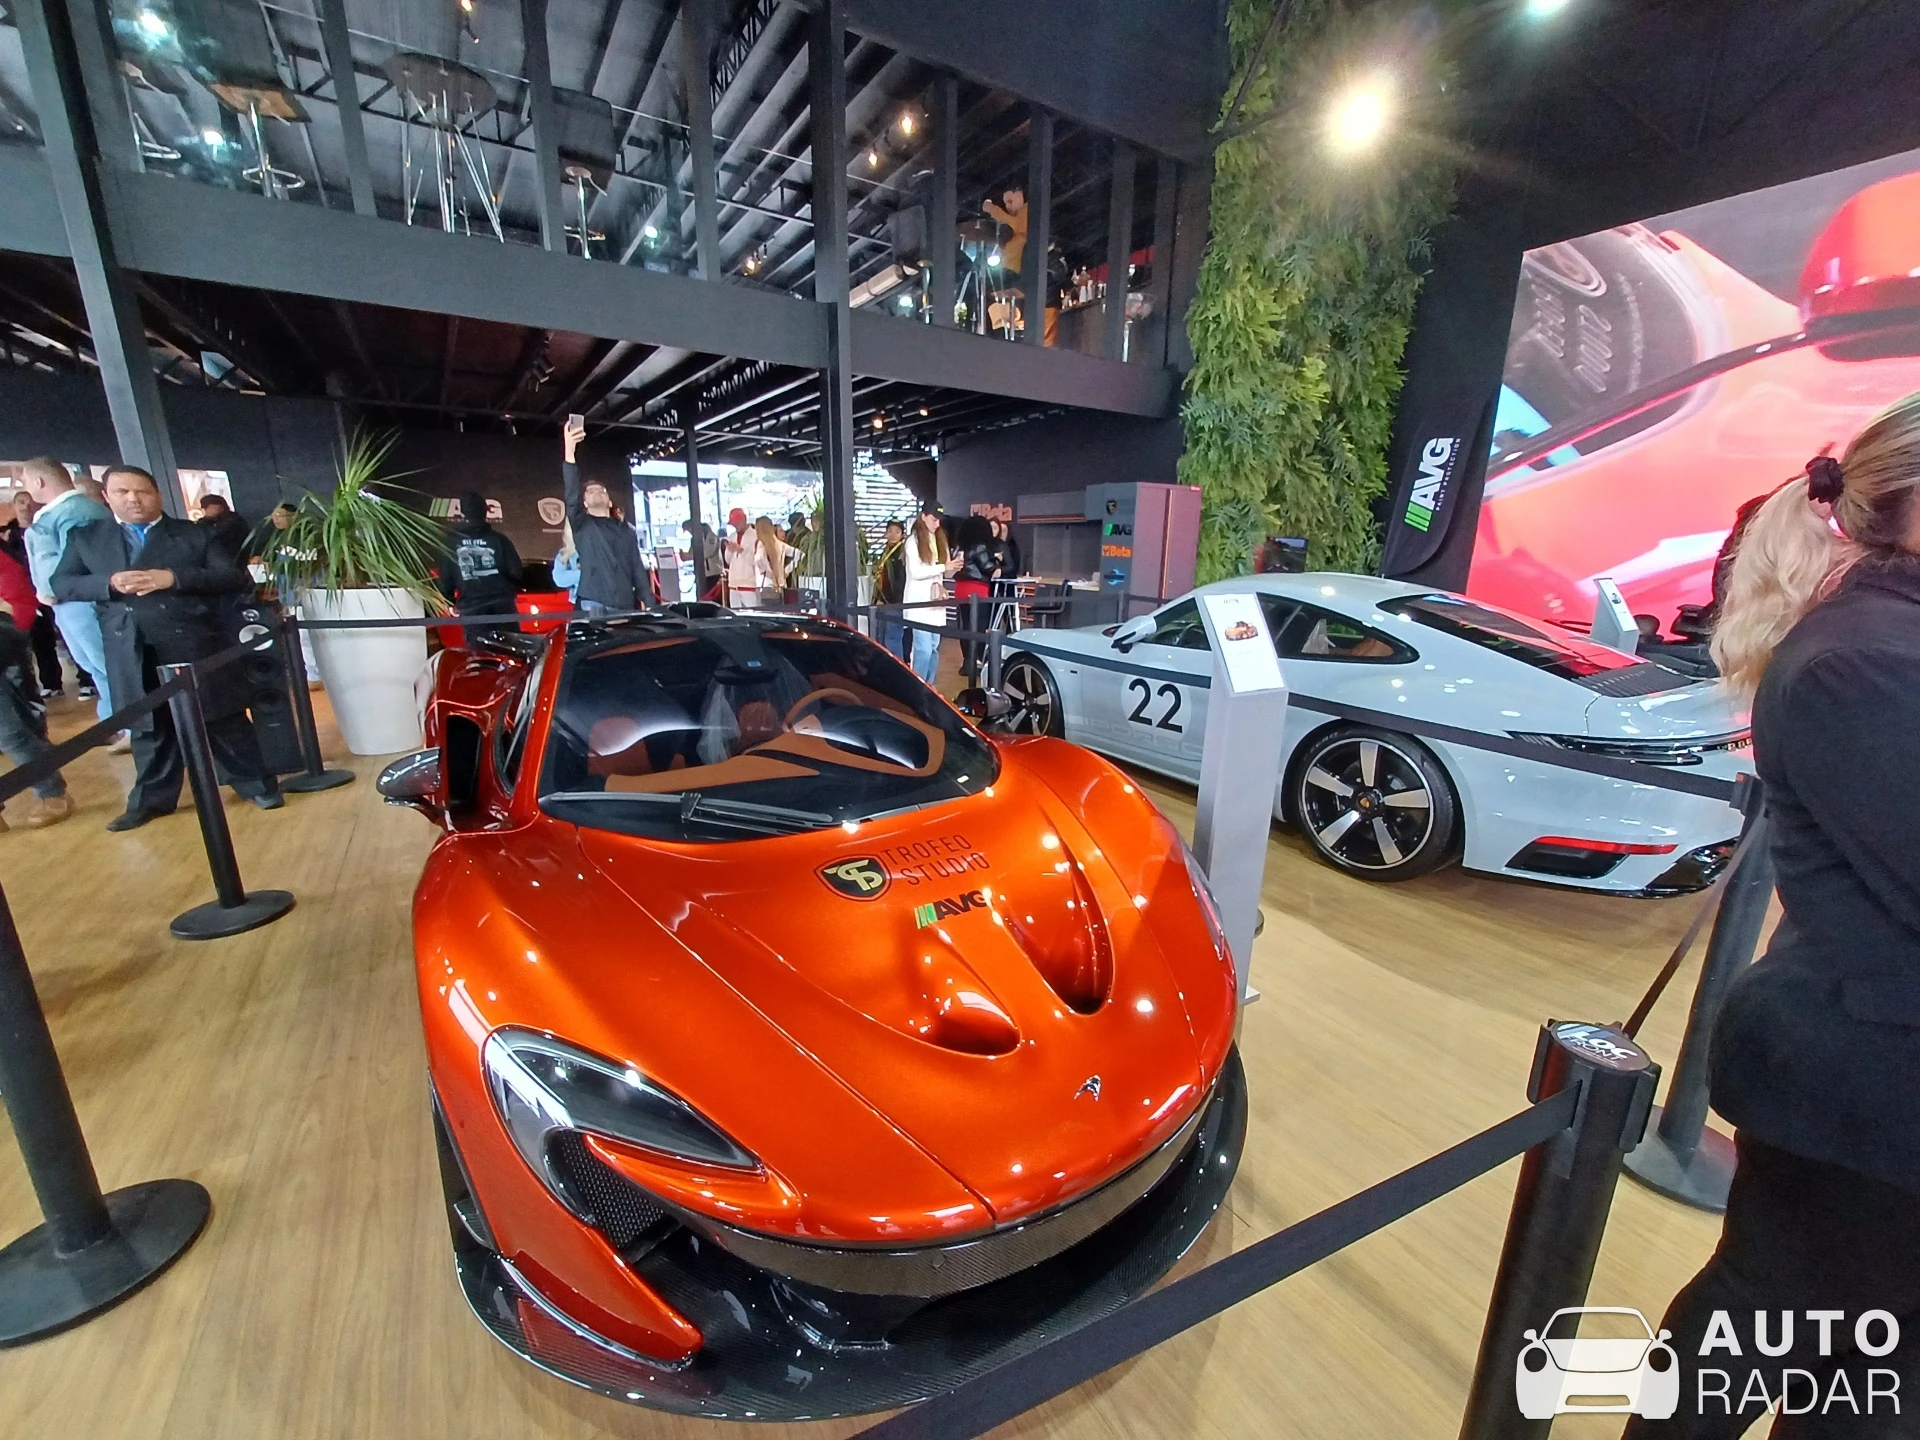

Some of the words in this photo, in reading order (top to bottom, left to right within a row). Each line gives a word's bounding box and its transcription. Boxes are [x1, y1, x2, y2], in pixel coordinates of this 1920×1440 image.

[1410, 437, 1454, 510] AVG
[1435, 489, 1446, 511] PAINT
[1443, 438, 1461, 486] PROTECTION
[446, 497, 503, 519] AG
[1110, 523, 1132, 536] AVG
[1127, 678, 1183, 734] 22
[882, 833, 972, 866] TROFEO
[900, 852, 991, 886] STUDIO
[935, 889, 993, 921] AVG
